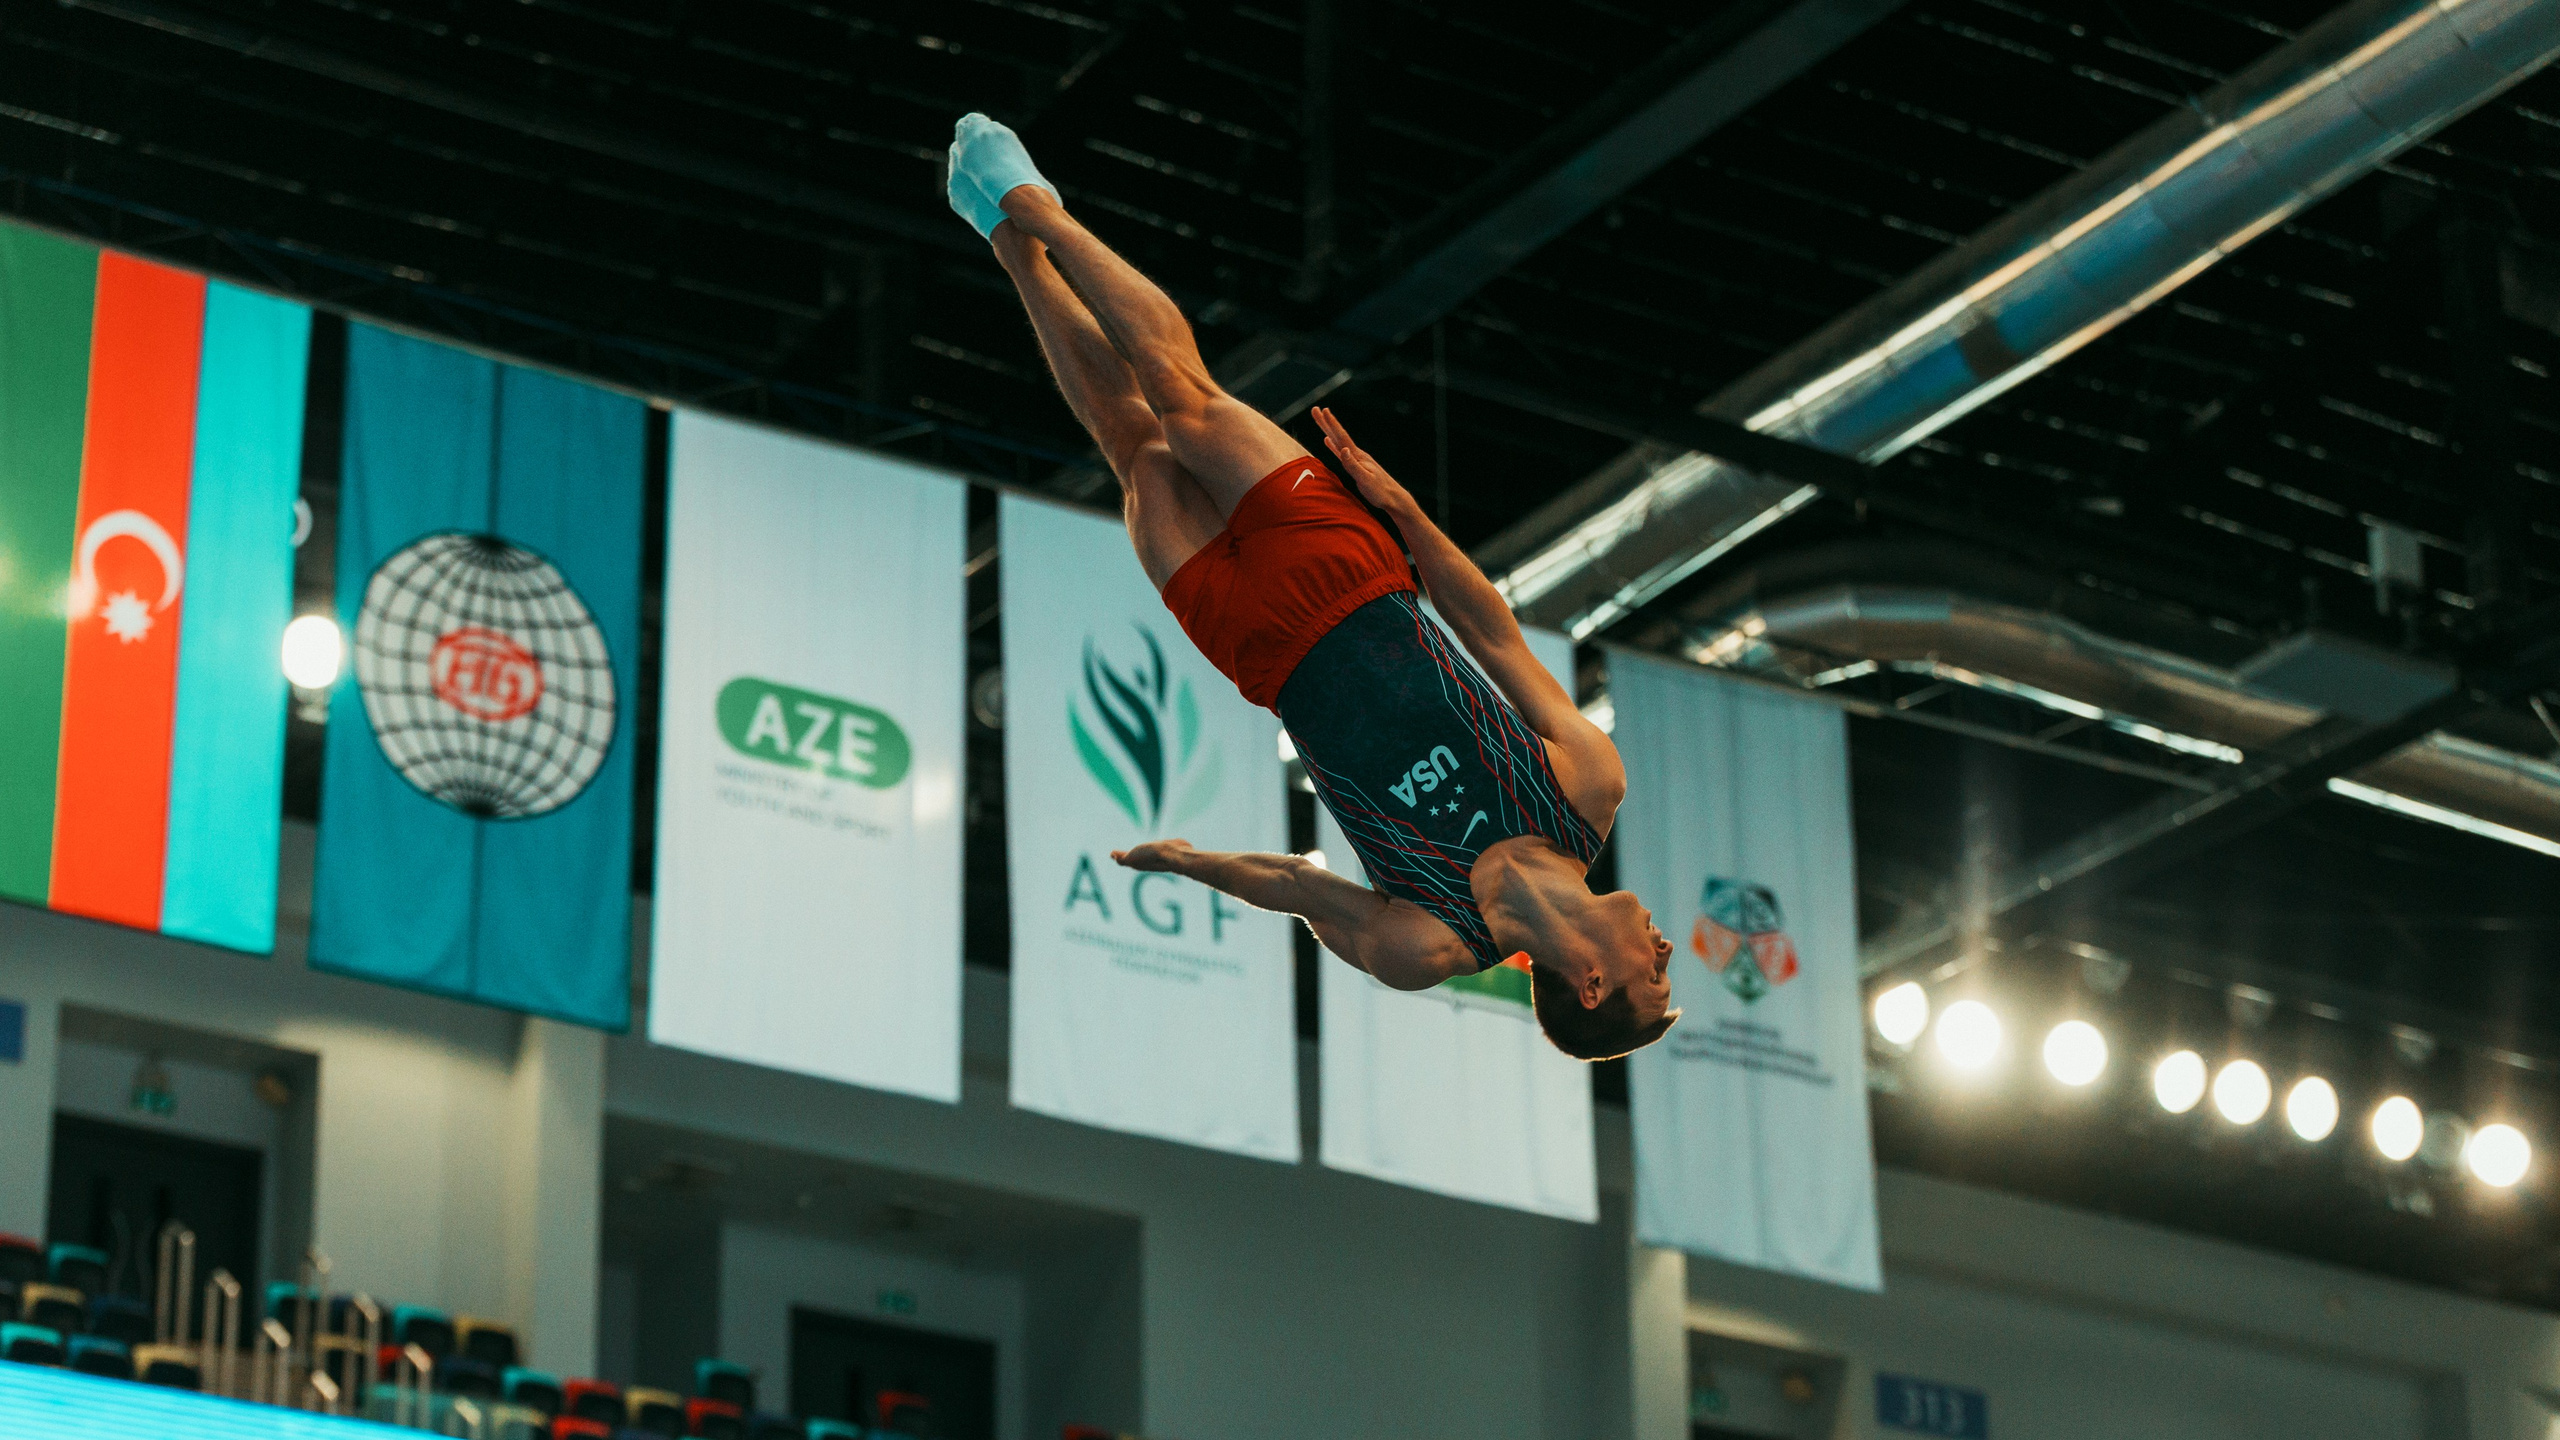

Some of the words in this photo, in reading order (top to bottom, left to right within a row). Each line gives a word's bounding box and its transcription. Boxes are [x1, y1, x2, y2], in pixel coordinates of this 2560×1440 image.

[745, 693, 877, 776] AZE
[1388, 745, 1460, 808] USA
[1064, 852, 1240, 945] AGF
